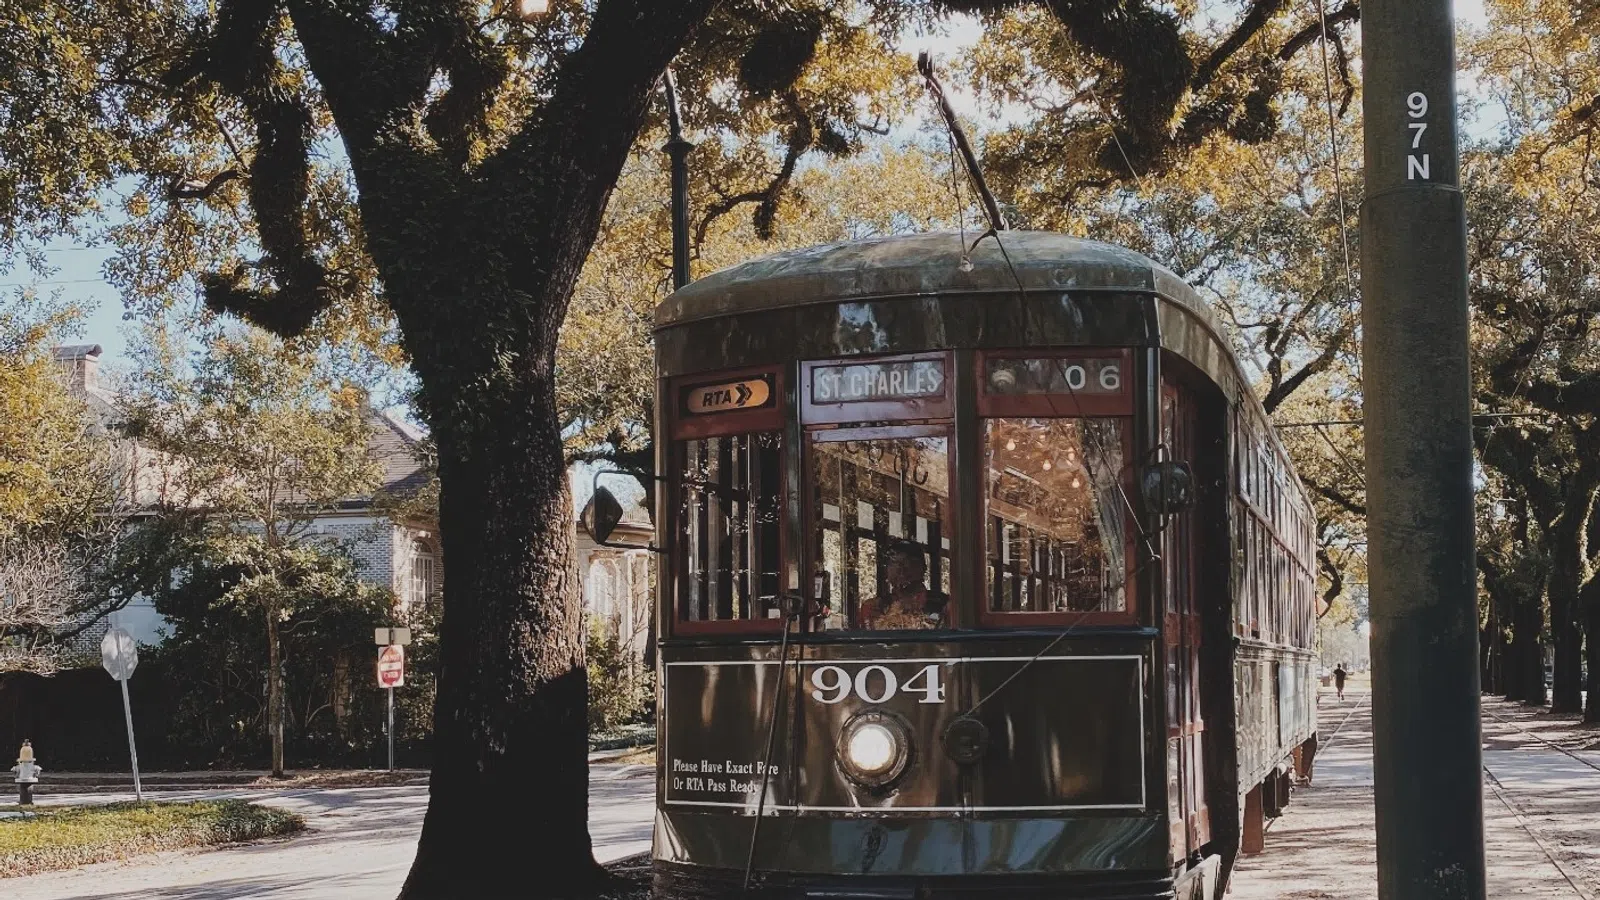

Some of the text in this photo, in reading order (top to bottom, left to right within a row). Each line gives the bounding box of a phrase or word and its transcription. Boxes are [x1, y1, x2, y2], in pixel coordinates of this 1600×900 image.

[1407, 91, 1430, 180] 97N
[851, 367, 941, 397] CHARLES
[702, 391, 732, 407] RTA
[811, 665, 946, 704] 904
[673, 758, 698, 773] Please
[701, 760, 722, 774] Have
[726, 760, 753, 775] Exact
[673, 777, 759, 795] Or RTA Pass Ready
